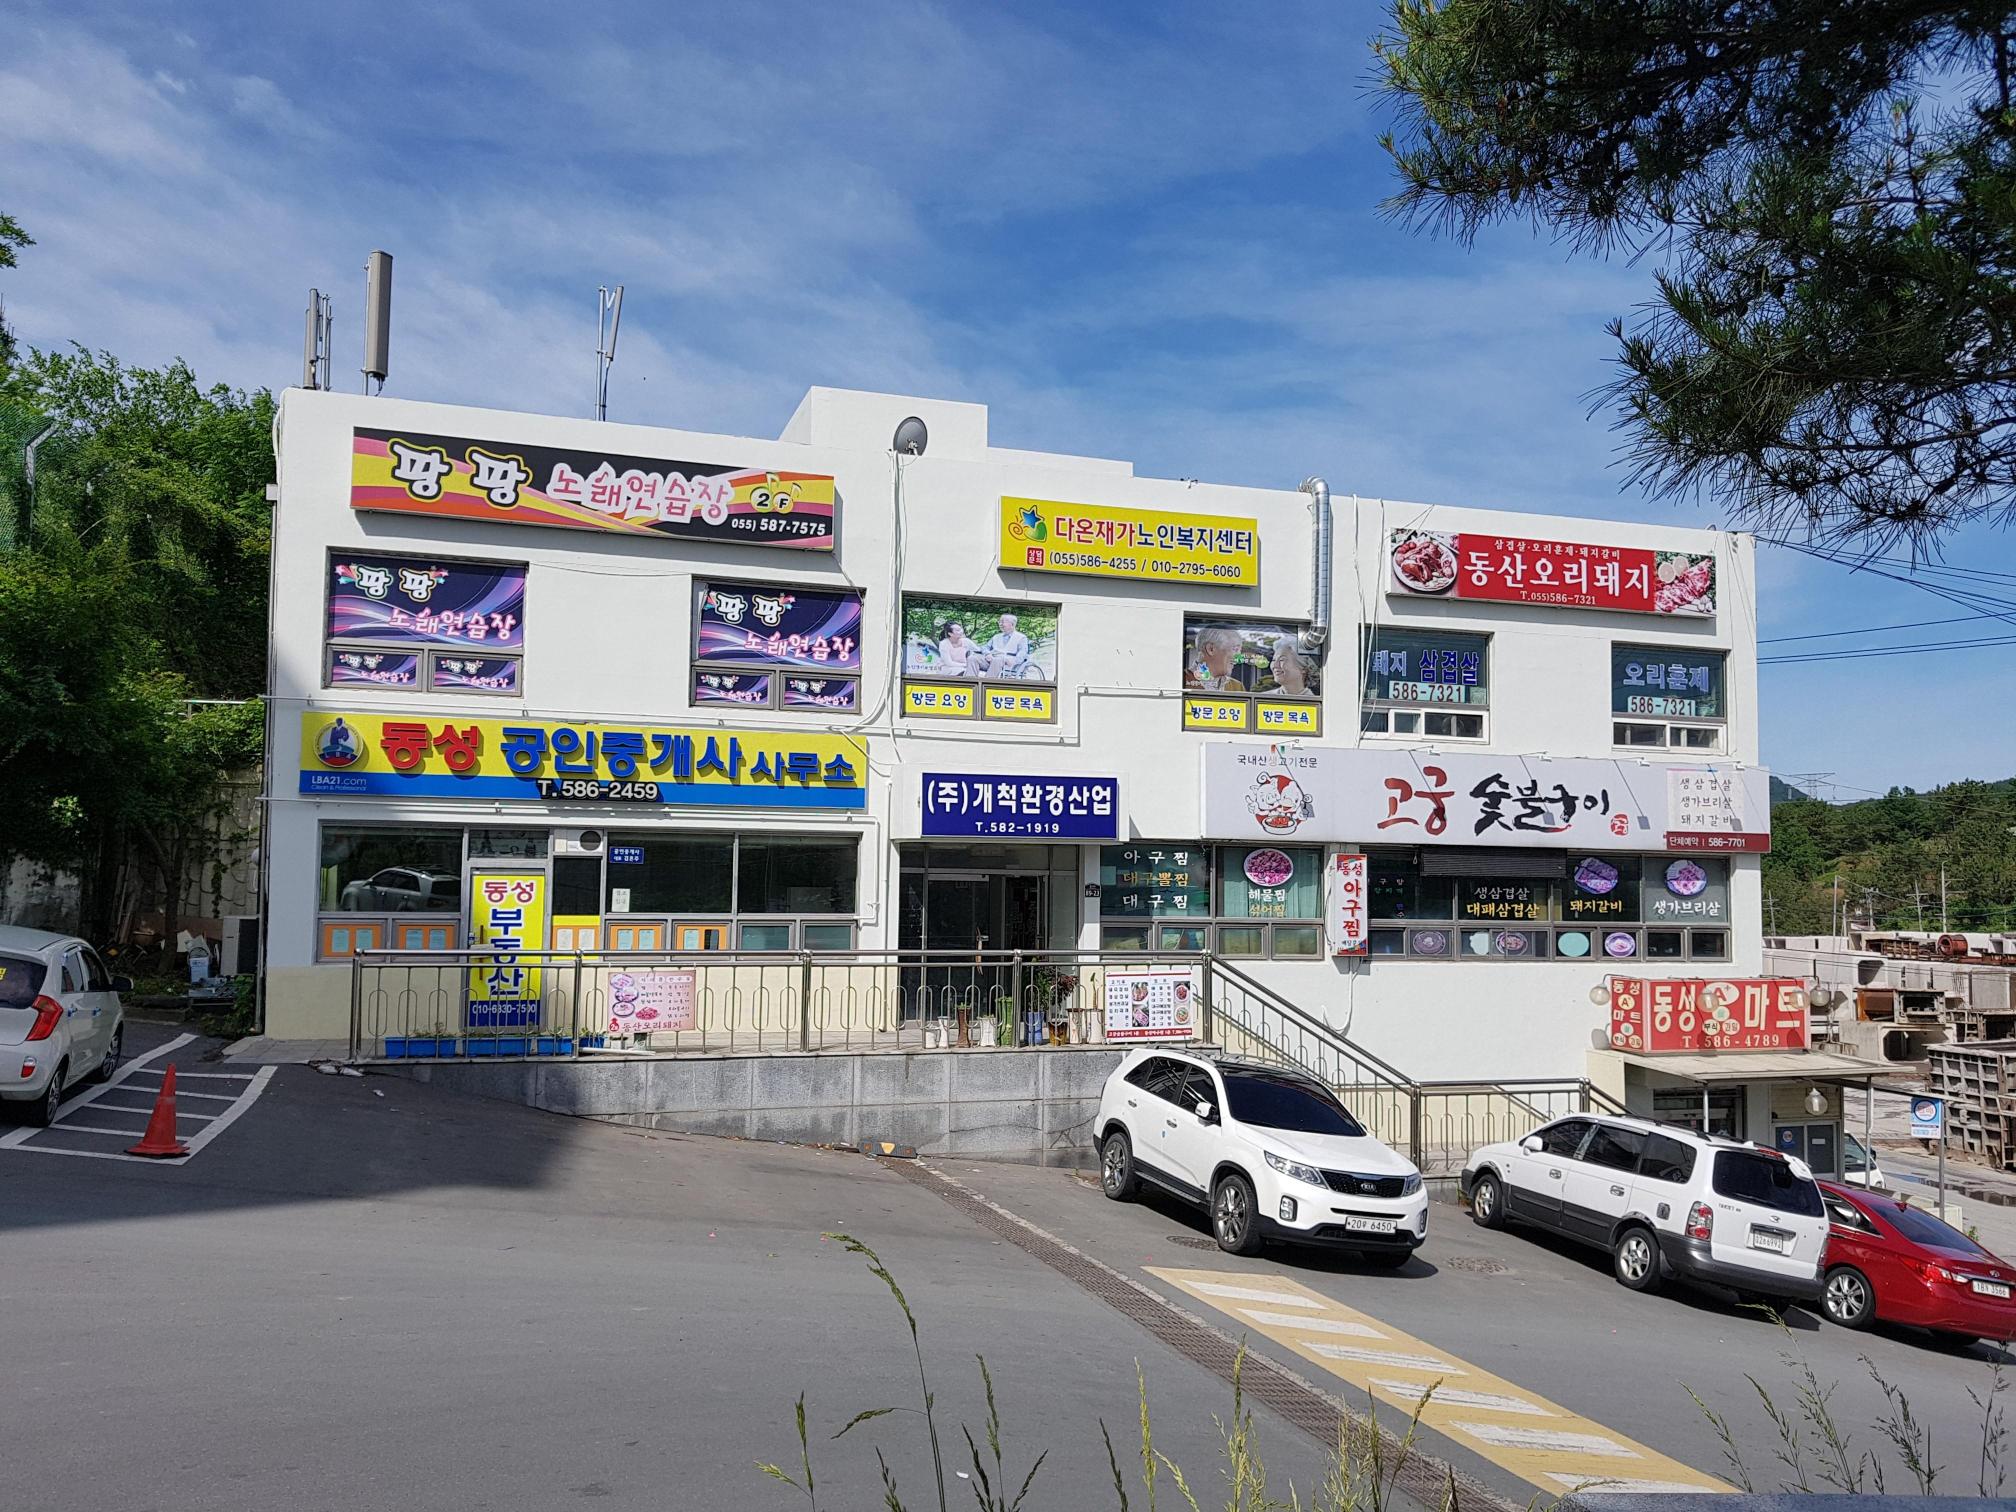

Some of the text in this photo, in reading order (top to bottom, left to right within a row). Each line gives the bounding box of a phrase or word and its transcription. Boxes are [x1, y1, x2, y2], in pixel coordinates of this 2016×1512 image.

[551, 468, 730, 520] 노래연습장
[756, 492, 788, 510] 2F
[731, 519, 826, 536] 055) 587-7575
[1049, 552, 1137, 570] (055)586-4255
[1151, 560, 1241, 577] 010-2795-6060
[1463, 550, 1650, 600] 동산오리돼지
[388, 607, 516, 640] 노래연습장
[744, 631, 855, 662] 노래연습장
[1372, 649, 1480, 685] 돼지 삼겹살
[1623, 662, 1709, 693] 오리훈제
[911, 692, 967, 708] 방문 요양
[1392, 682, 1462, 702] 586-7321
[992, 696, 1043, 711] 방문 목욕
[1631, 696, 1692, 716] 586-7321
[1191, 705, 1241, 721] 방문 요양
[1263, 710, 1309, 724] 방문 목욕
[380, 721, 856, 782] 동성 공인중개사 사무소
[311, 775, 367, 786] LBA21.com
[1680, 777, 1732, 792] 생삼겹살
[538, 780, 658, 800] T.586-2459
[927, 780, 1112, 816] (주)개척환경산업
[1377, 766, 1610, 837] 고궁 숯불구이
[1680, 795, 1733, 809] 생가브리살
[975, 821, 1060, 834] T.582-1919
[1681, 813, 1732, 826] 돼지갈비
[1708, 837, 1746, 848] 586-7701
[1123, 849, 1189, 866] 아구찜
[1340, 862, 1363, 876] 동성
[1123, 872, 1189, 887] 대구뽈찜
[484, 881, 535, 903] 동성
[1248, 888, 1286, 902] 해물찜
[1474, 886, 1531, 901] 생삼겹살
[1122, 893, 1188, 909] 대구찜
[1341, 878, 1362, 937] 아구찜
[1570, 899, 1623, 914] 돼지갈비
[1652, 899, 1721, 916] 생가브리살
[1466, 902, 1540, 919] 대패삼겹살
[487, 908, 525, 997] 부동산
[1653, 984, 1696, 1033] 동성
[1745, 983, 1801, 1031] 마트
[1370, 1221, 1392, 1232] 6450
